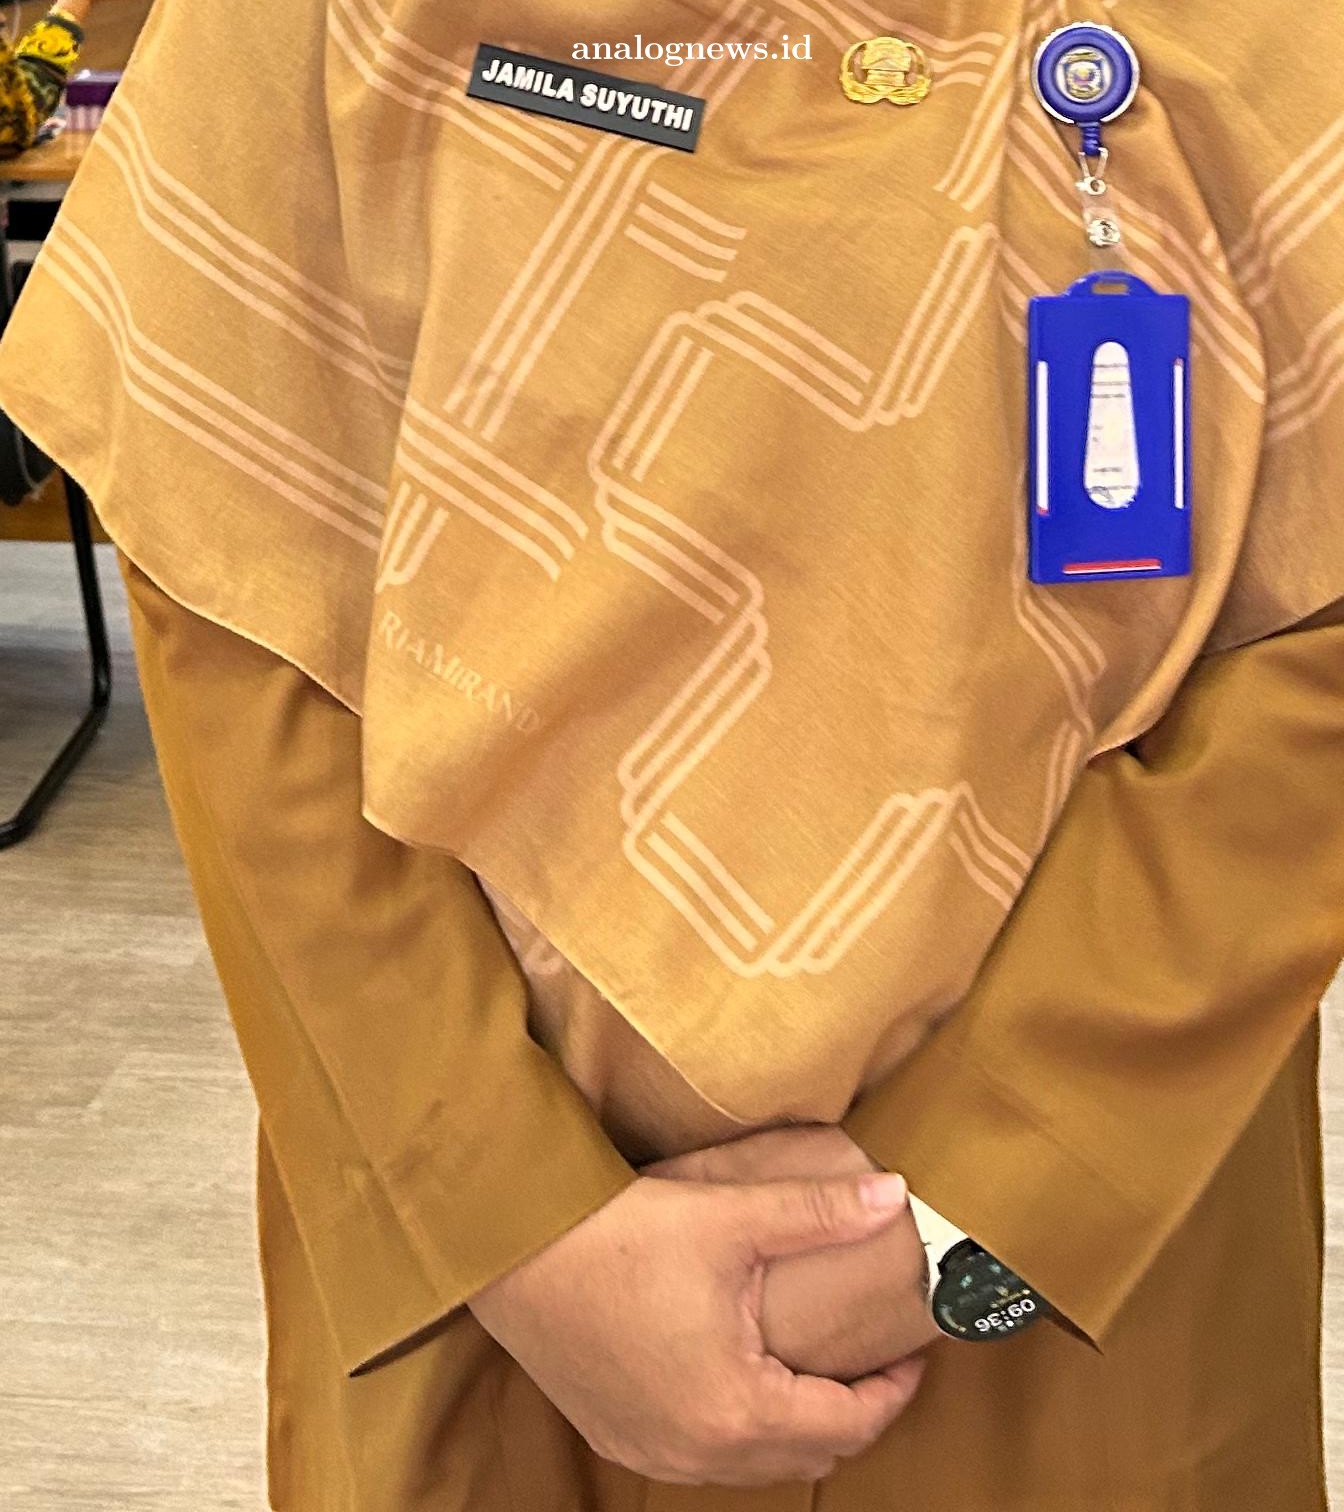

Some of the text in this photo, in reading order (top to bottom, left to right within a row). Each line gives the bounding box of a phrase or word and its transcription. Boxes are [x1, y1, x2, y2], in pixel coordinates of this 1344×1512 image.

[481, 58, 695, 133] JAMILA SUYUTHI
[975, 1299, 1036, 1332] 09:36
